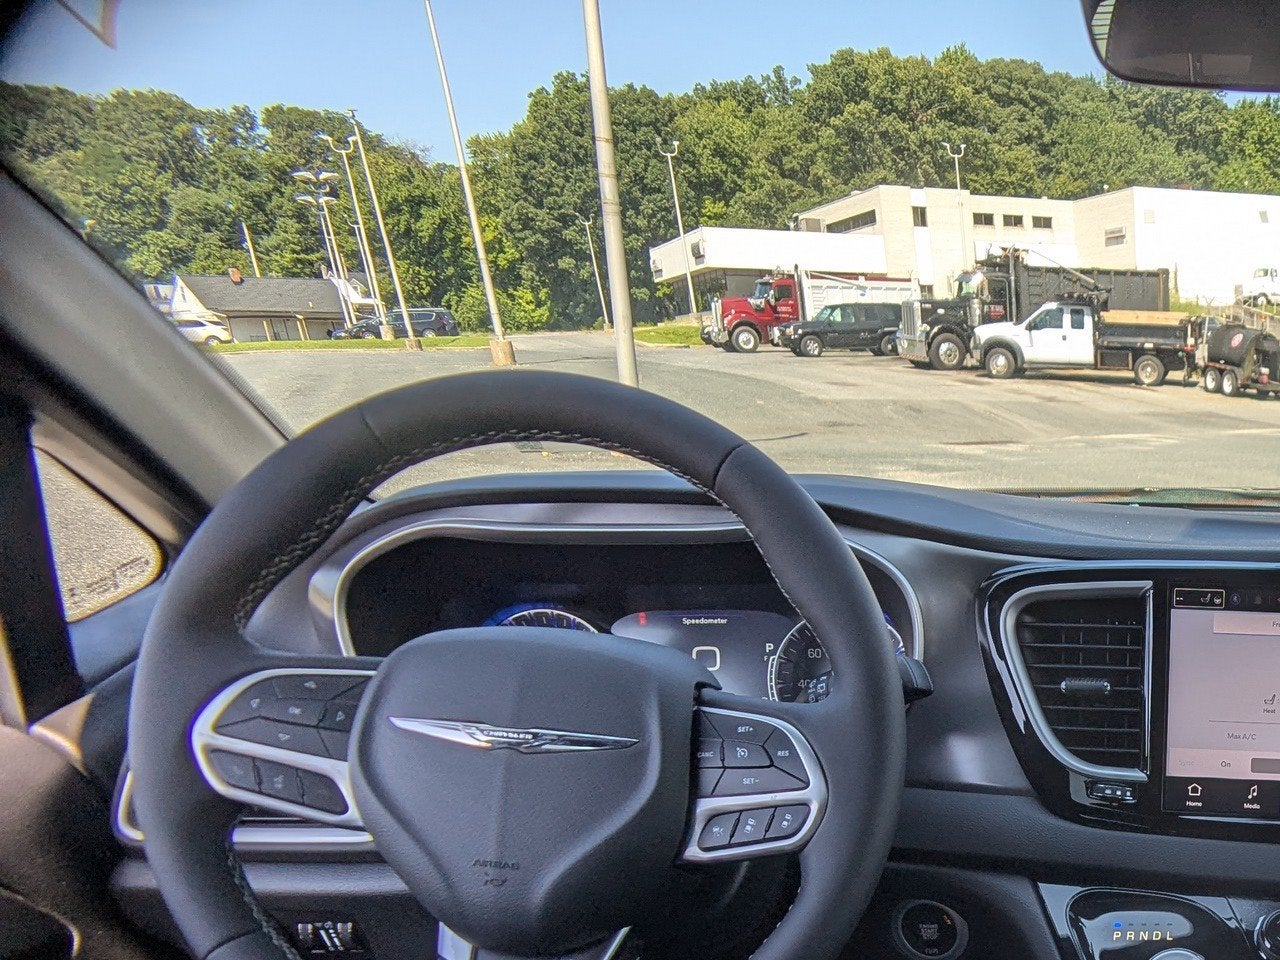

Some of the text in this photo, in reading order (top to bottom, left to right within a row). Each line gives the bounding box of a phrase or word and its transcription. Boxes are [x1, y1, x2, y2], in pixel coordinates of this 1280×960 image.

[682, 617, 728, 625] Speedometer
[765, 643, 774, 653] P
[807, 648, 822, 659] 60
[1227, 731, 1257, 741] Max A/C
[777, 749, 790, 757] RES
[1220, 760, 1231, 768] On
[1186, 800, 1203, 808] Home
